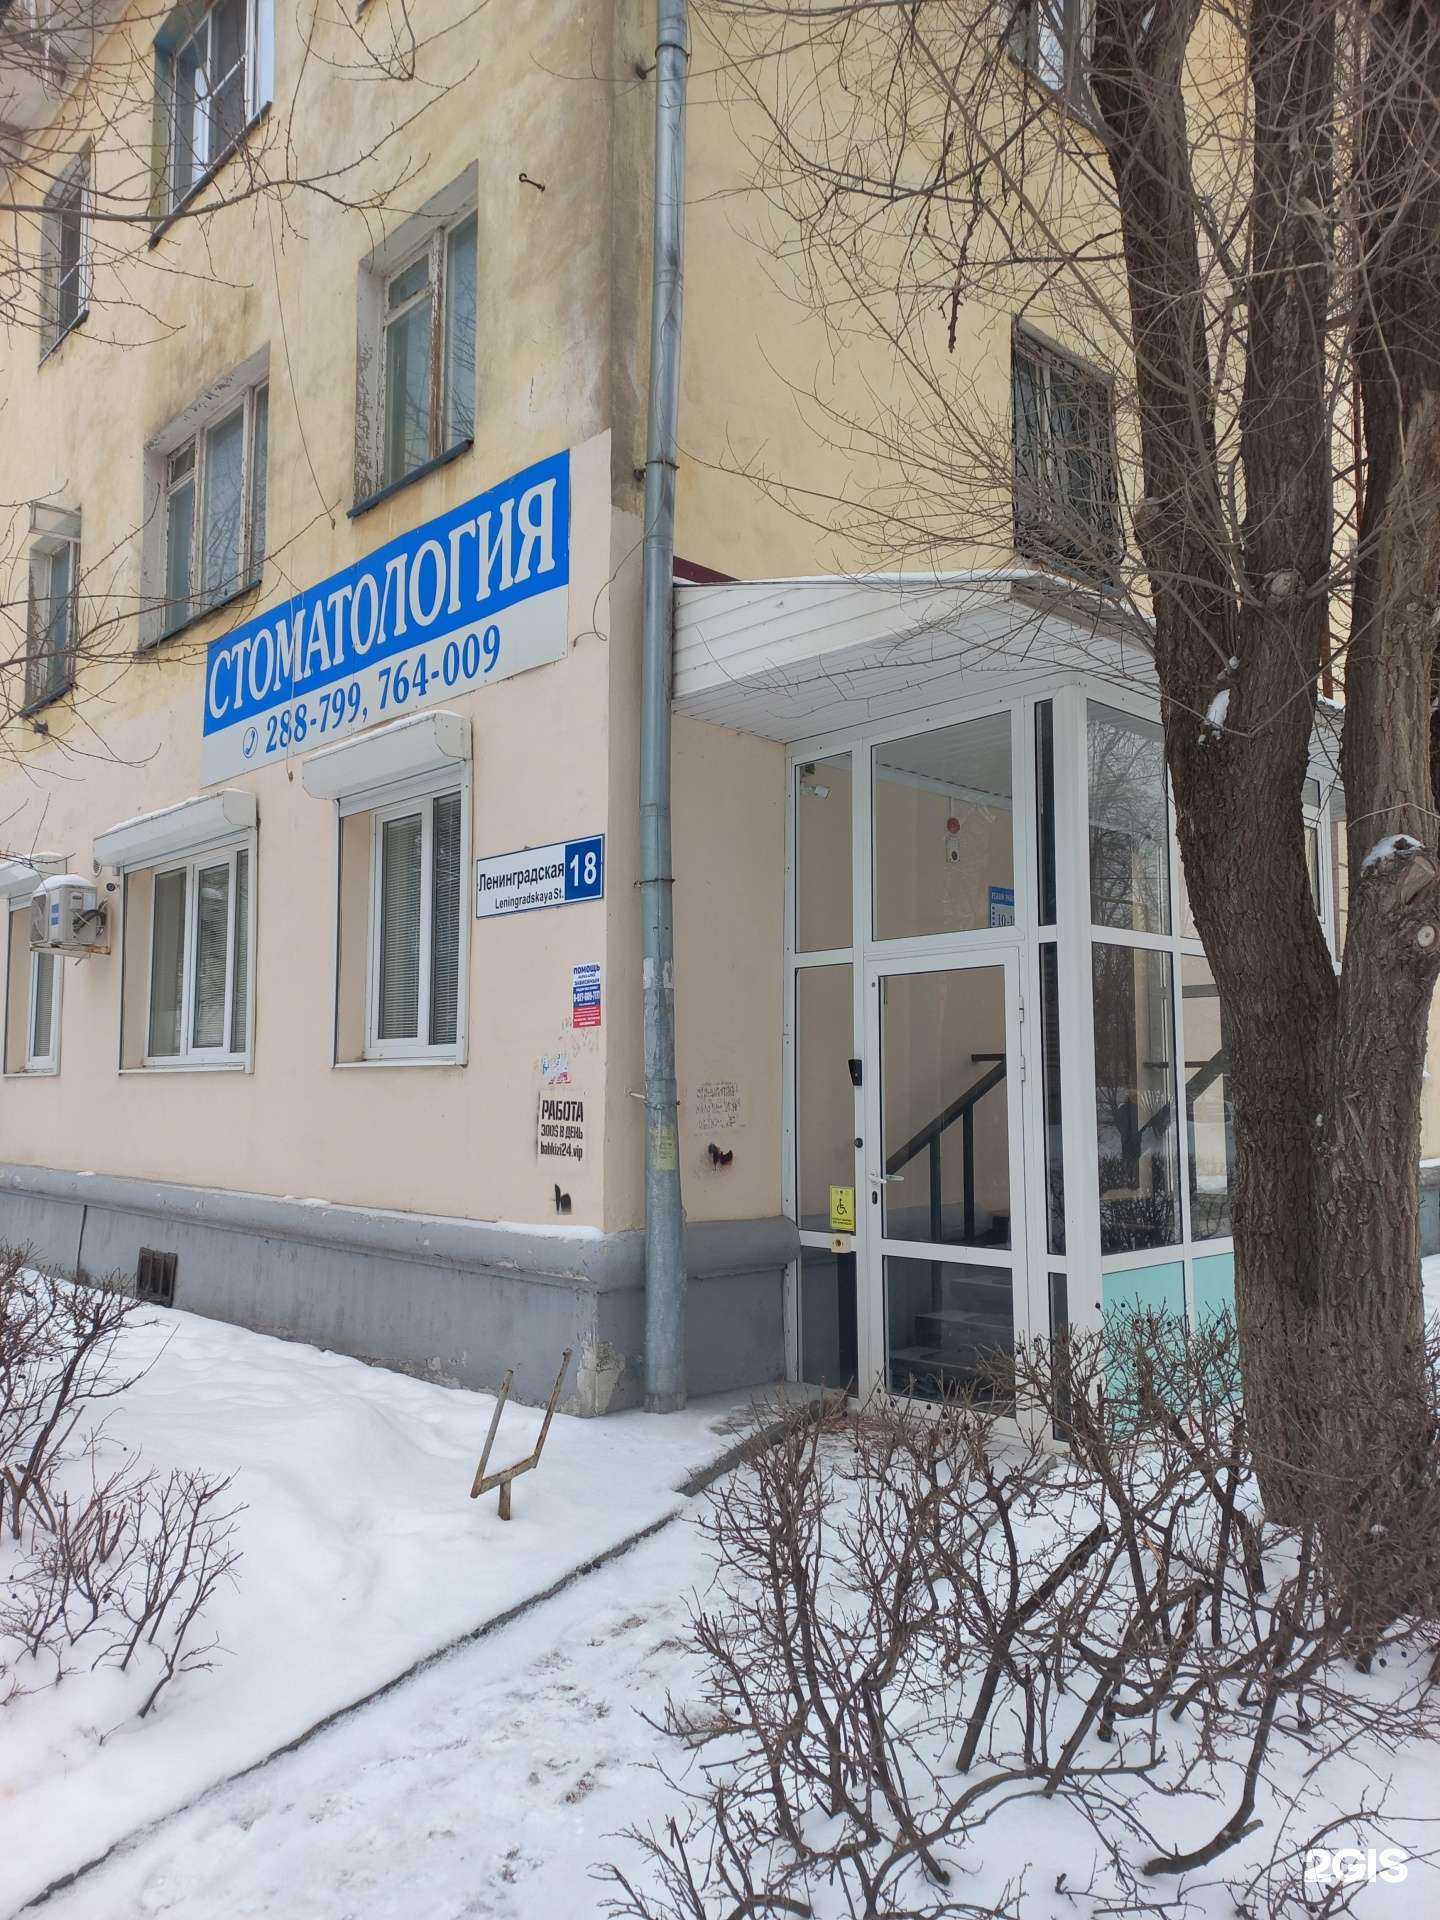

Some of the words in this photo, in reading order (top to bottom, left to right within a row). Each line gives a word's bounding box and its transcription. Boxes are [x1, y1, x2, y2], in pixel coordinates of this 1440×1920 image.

[208, 477, 557, 719] СТОМАТОЛОГИЯ
[265, 681, 368, 754] 288-799,
[378, 624, 501, 710] 764-009
[478, 862, 564, 892] Ленинградская
[570, 851, 597, 887] 18
[495, 890, 553, 910] Leningradskaya
[553, 888, 564, 899] St.
[573, 964, 601, 975] ПОМОЩЬ
[541, 1100, 584, 1122] РАБОТА
[565, 1126, 583, 1140] ДЕНЬ
